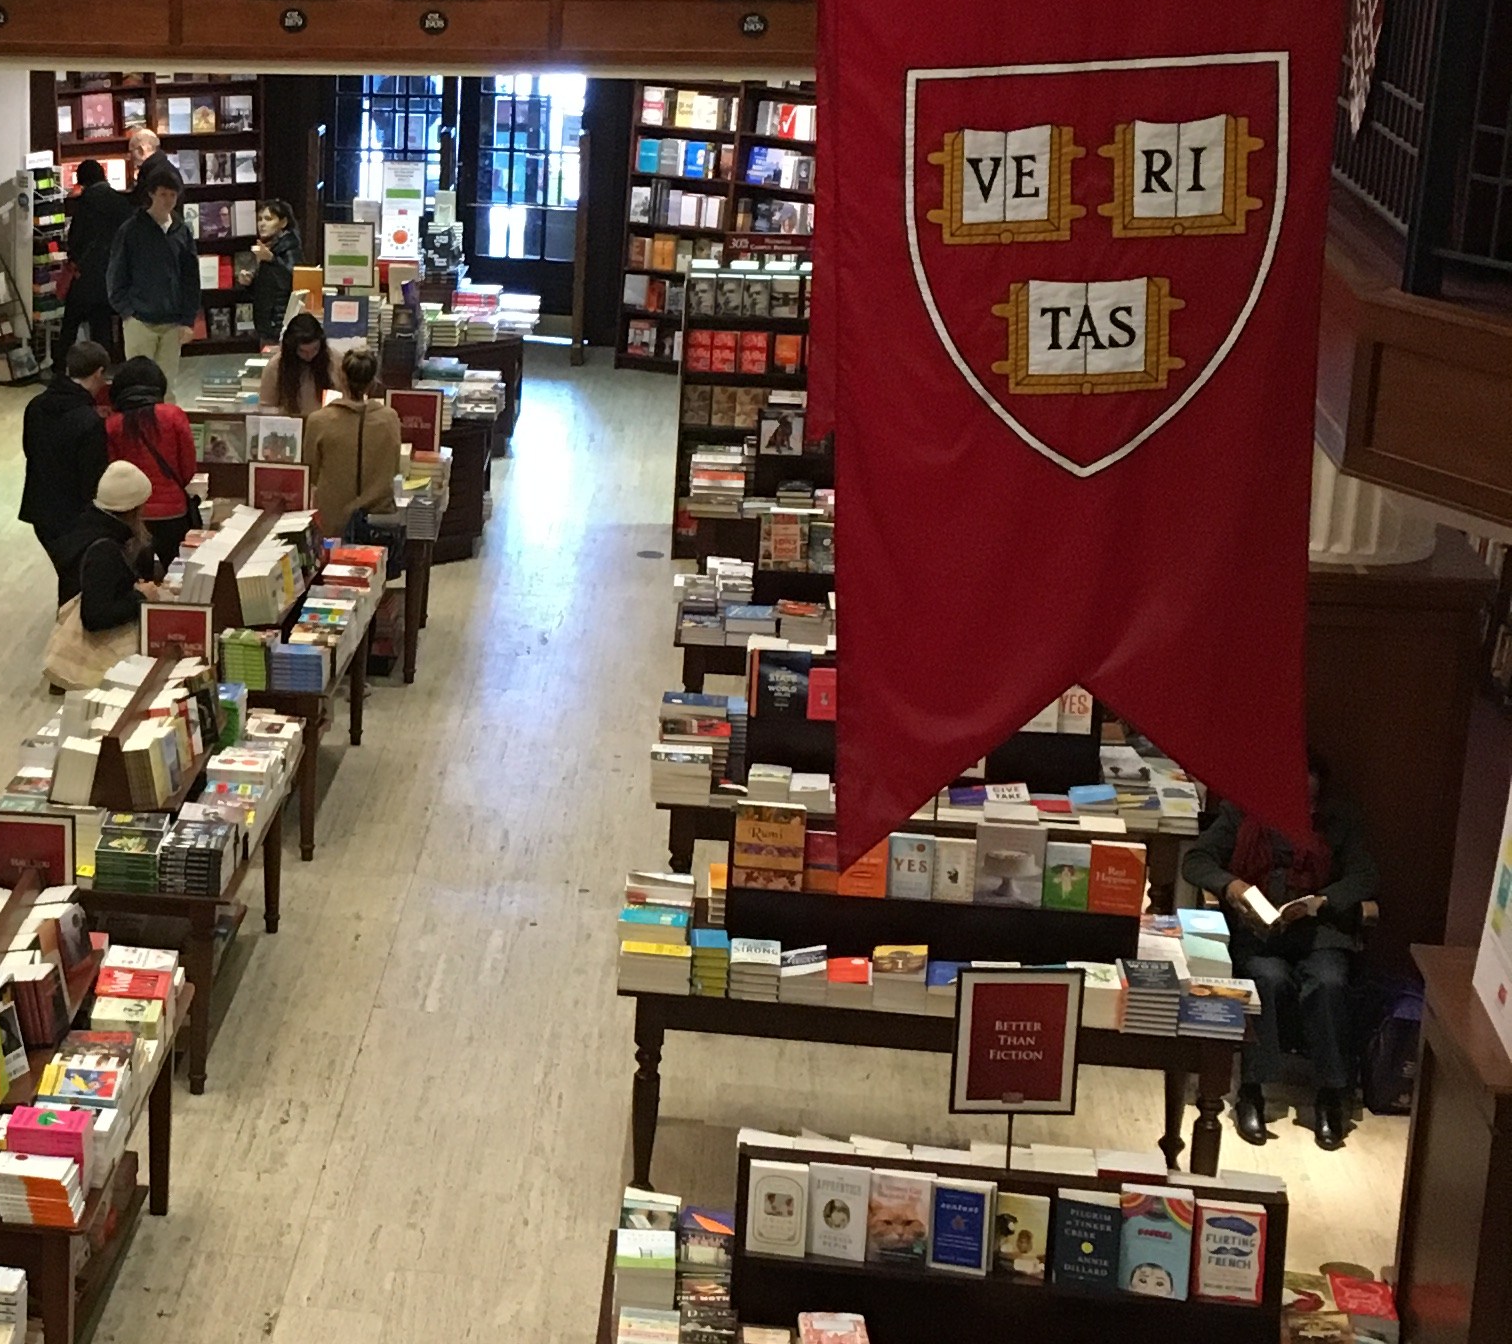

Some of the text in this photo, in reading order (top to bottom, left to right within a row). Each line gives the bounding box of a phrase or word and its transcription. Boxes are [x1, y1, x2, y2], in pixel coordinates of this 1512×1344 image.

[965, 145, 1205, 203] VE RI
[1040, 304, 1136, 353] TAS
[1060, 694, 1088, 715] YES
[749, 826, 784, 841] Rumi
[893, 858, 928, 874] YES
[995, 1021, 1041, 1032] BETTER
[998, 1036, 1035, 1046] THAN
[989, 1050, 1043, 1061] FICTION
[1070, 1208, 1112, 1221] PILGRIM
[1075, 1220, 1112, 1232] TINKER
[1206, 1233, 1256, 1247] FLIRTING
[1207, 1256, 1252, 1269] FRENCH
